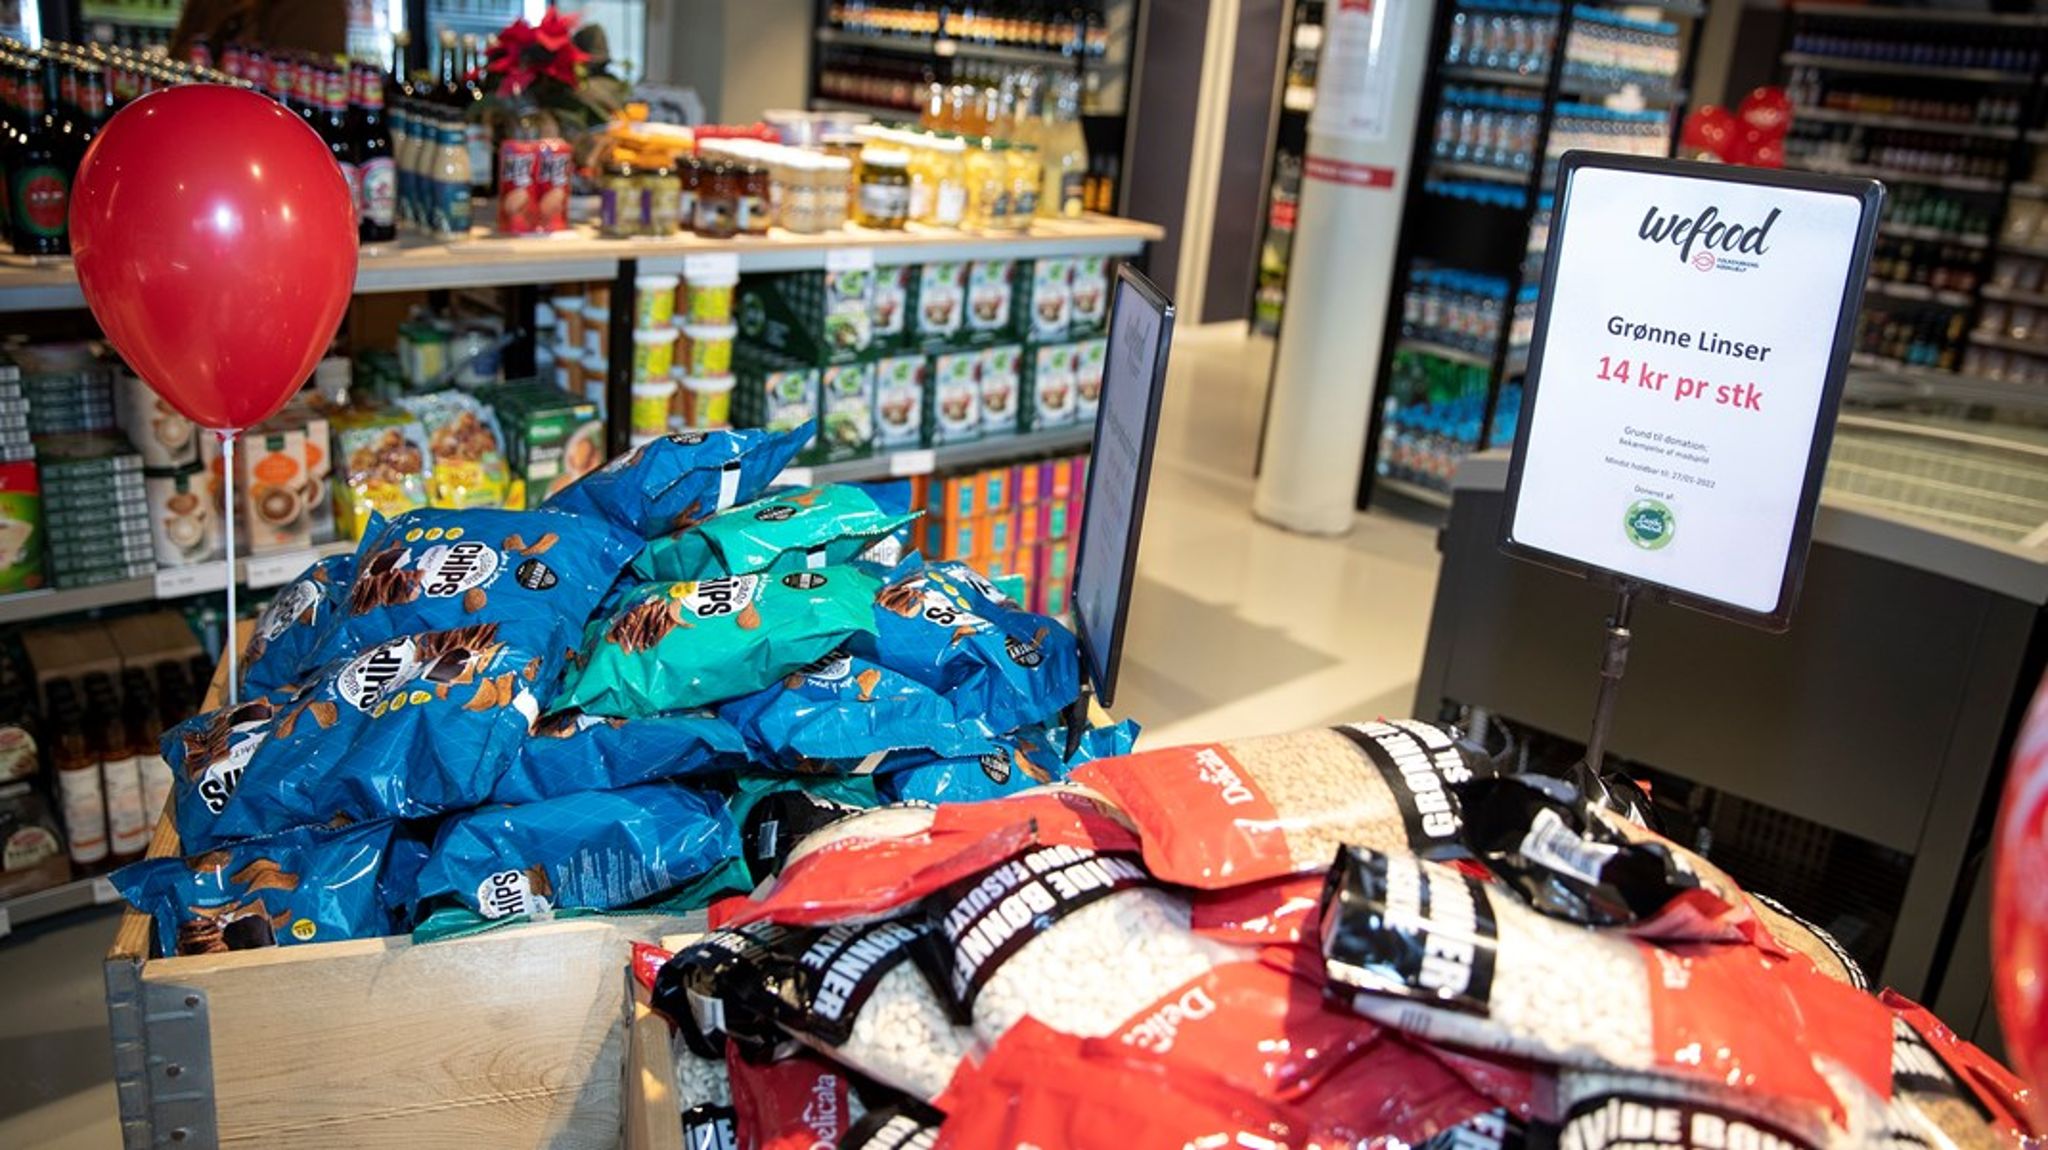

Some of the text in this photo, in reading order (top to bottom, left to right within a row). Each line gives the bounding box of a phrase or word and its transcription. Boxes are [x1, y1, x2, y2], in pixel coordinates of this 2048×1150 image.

[1638, 205, 1782, 264] wefood
[1606, 315, 1772, 363] Grønne Linser
[1596, 355, 1764, 412] 14 kr pr stk
[1623, 425, 1653, 440] Grund
[427, 543, 485, 597] CHiPS
